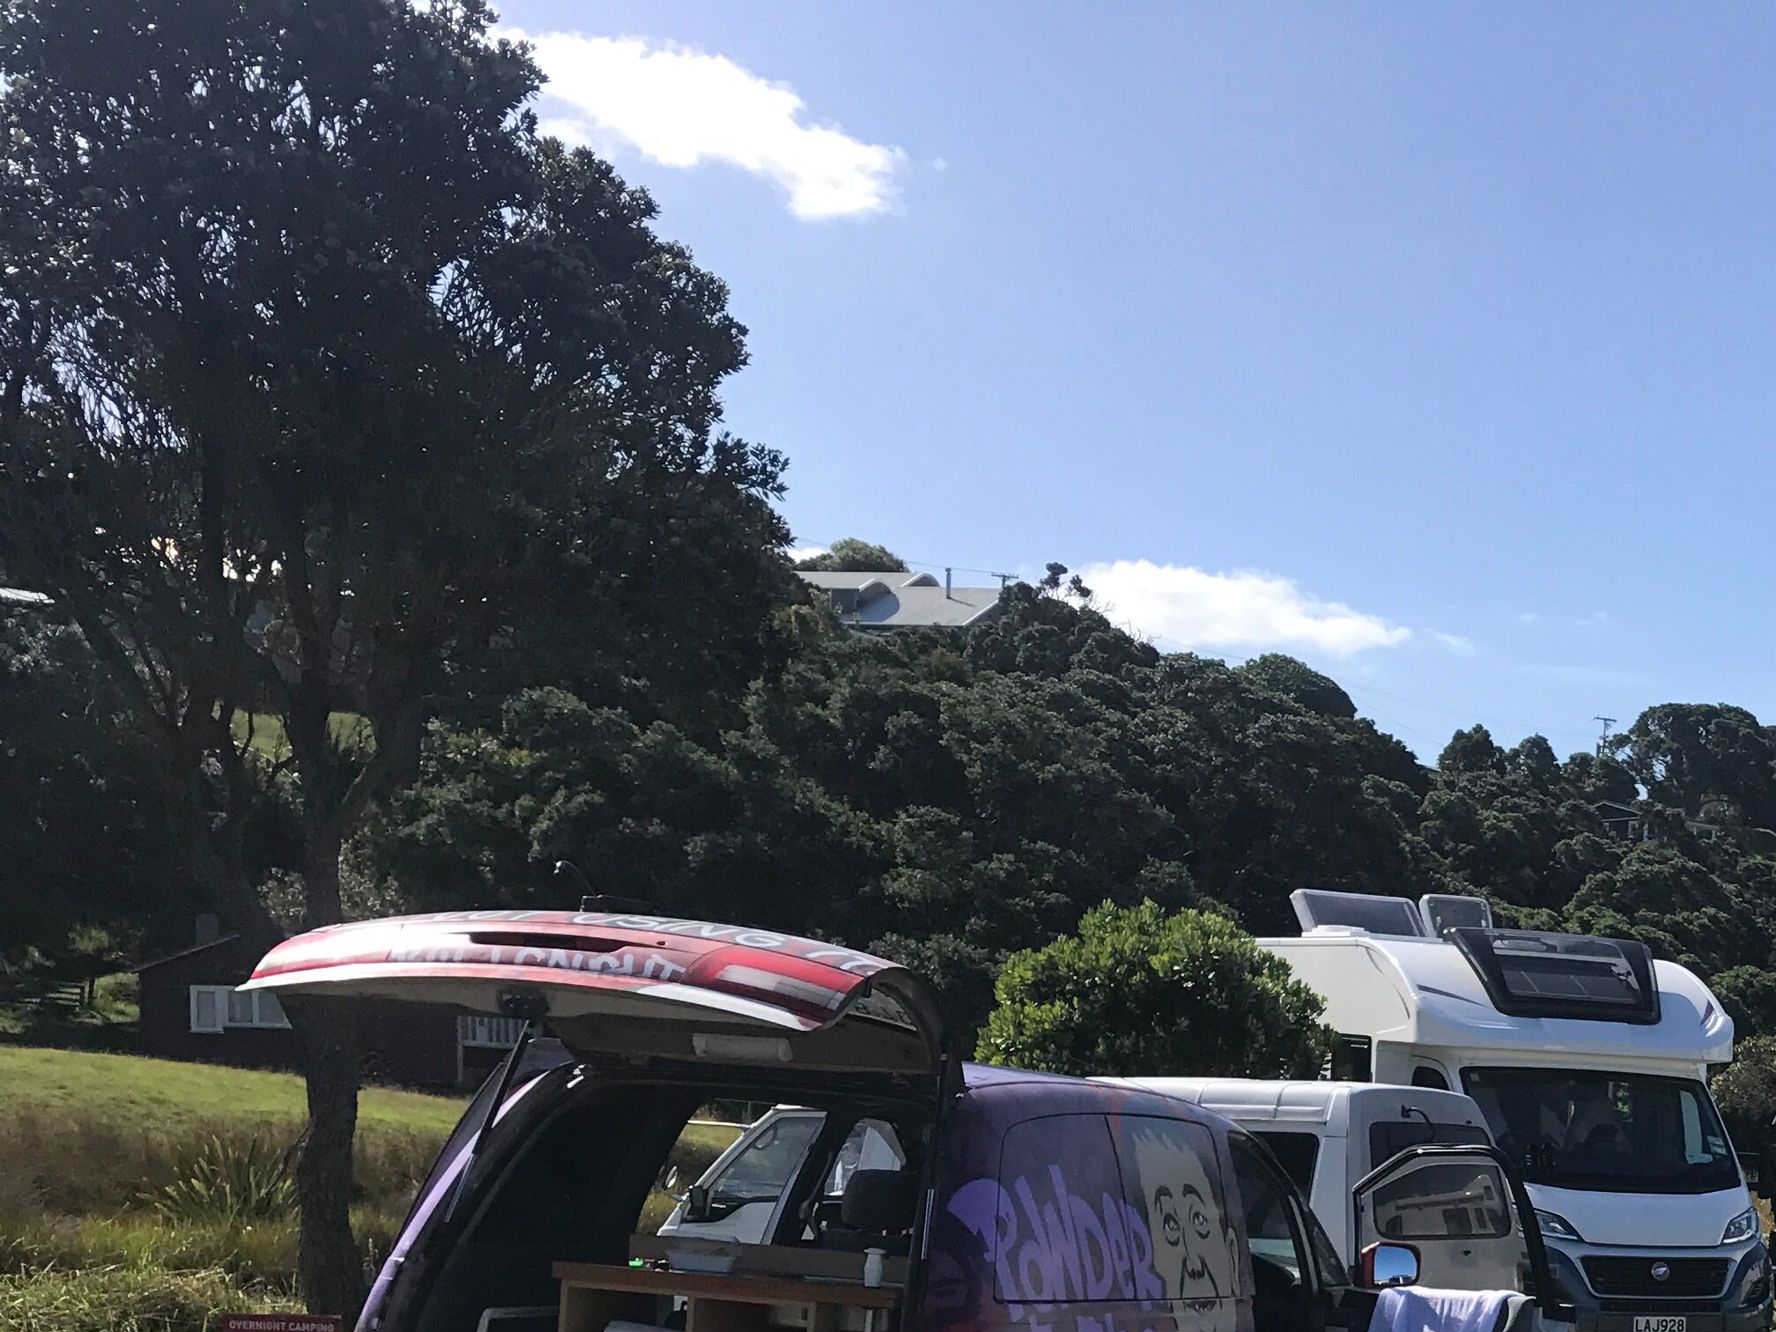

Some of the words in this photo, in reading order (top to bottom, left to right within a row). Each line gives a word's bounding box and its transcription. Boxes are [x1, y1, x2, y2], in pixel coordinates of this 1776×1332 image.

[572, 913, 786, 947] USING
[229, 1320, 285, 1331] OVERNIGHT
[288, 1322, 335, 1332] CAMPING
